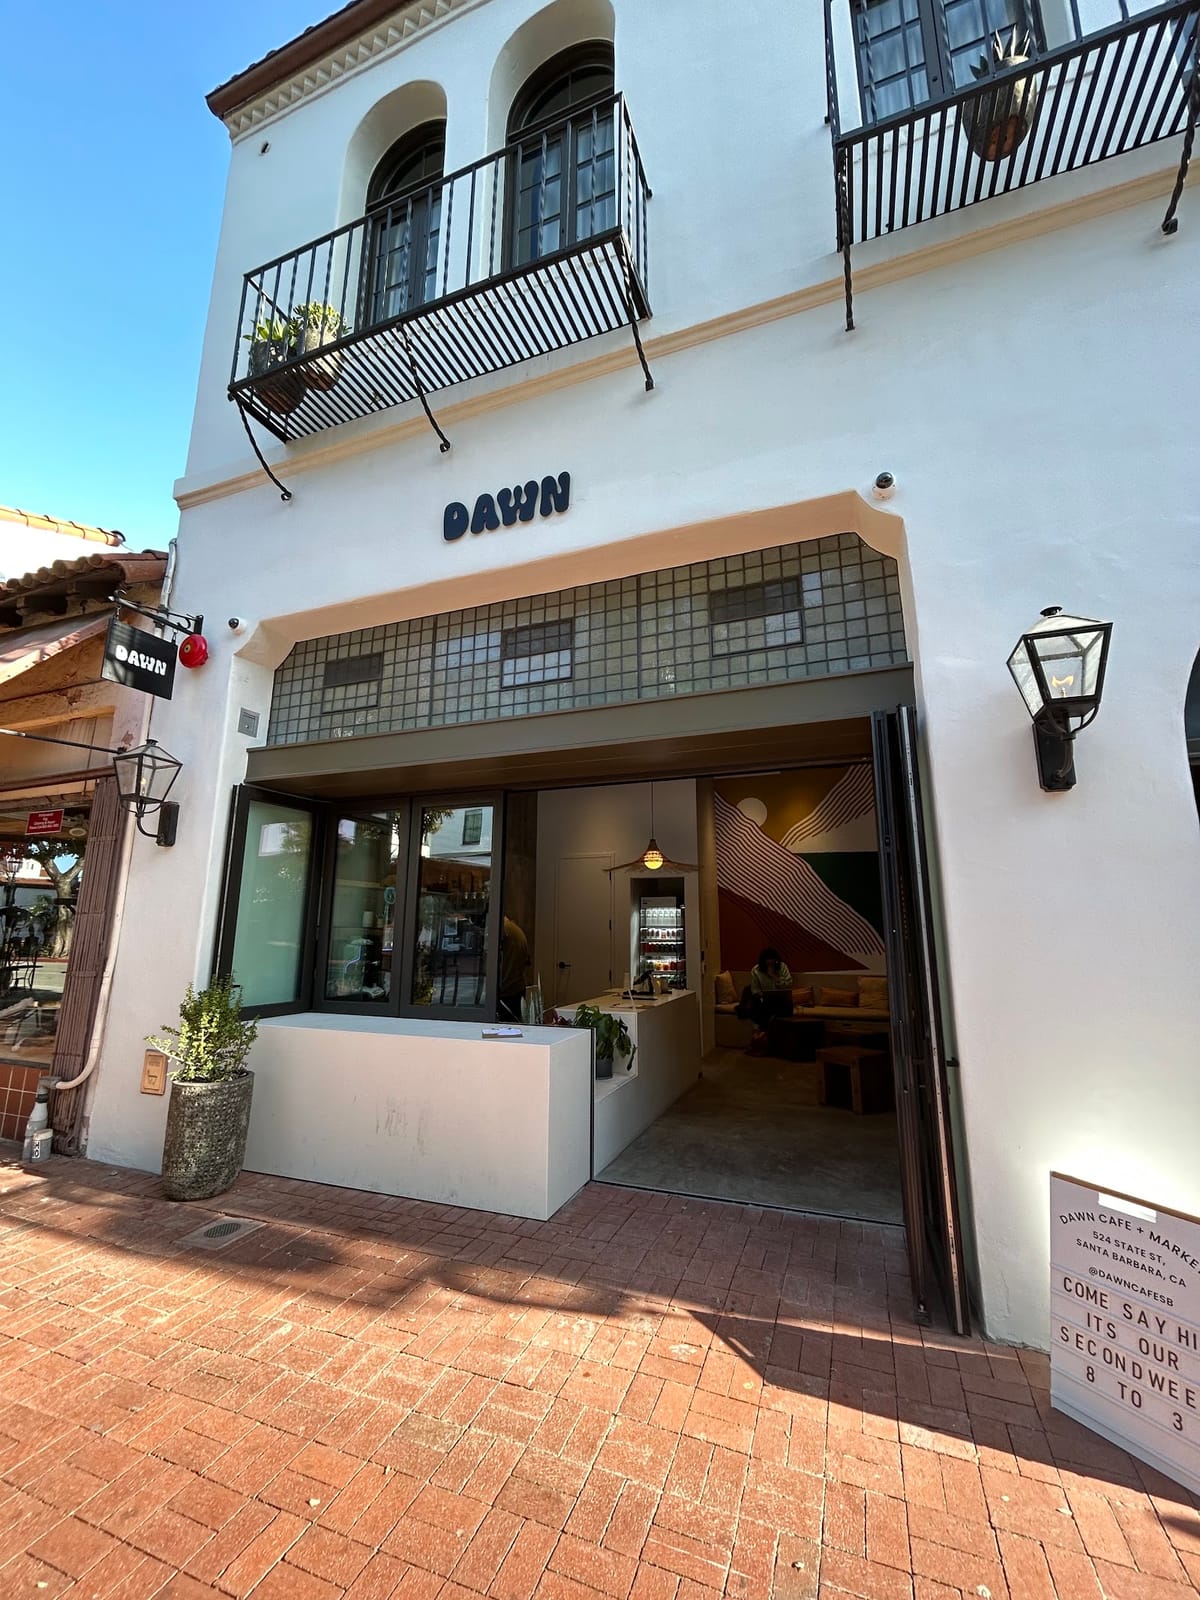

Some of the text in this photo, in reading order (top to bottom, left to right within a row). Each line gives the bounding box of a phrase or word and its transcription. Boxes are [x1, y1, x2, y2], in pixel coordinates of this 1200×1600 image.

[443, 471, 571, 541] DAWN
[115, 644, 167, 677] DAWN
[1059, 1211, 1095, 1225] DAWN
[1098, 1213, 1132, 1231] CAFE
[1149, 1231, 1200, 1275] MARKE
[1076, 1238, 1187, 1288] SANTA BARBARA, CA
[1092, 1230, 1111, 1244] 524
[1114, 1239, 1146, 1258] STATE
[1063, 1276, 1197, 1350] COME SAY HI
[1088, 1266, 1174, 1307] @DAWNCAFESB
[1087, 1312, 1179, 1371] ITS OUR
[1086, 1365, 1184, 1431] 8 TO 3
